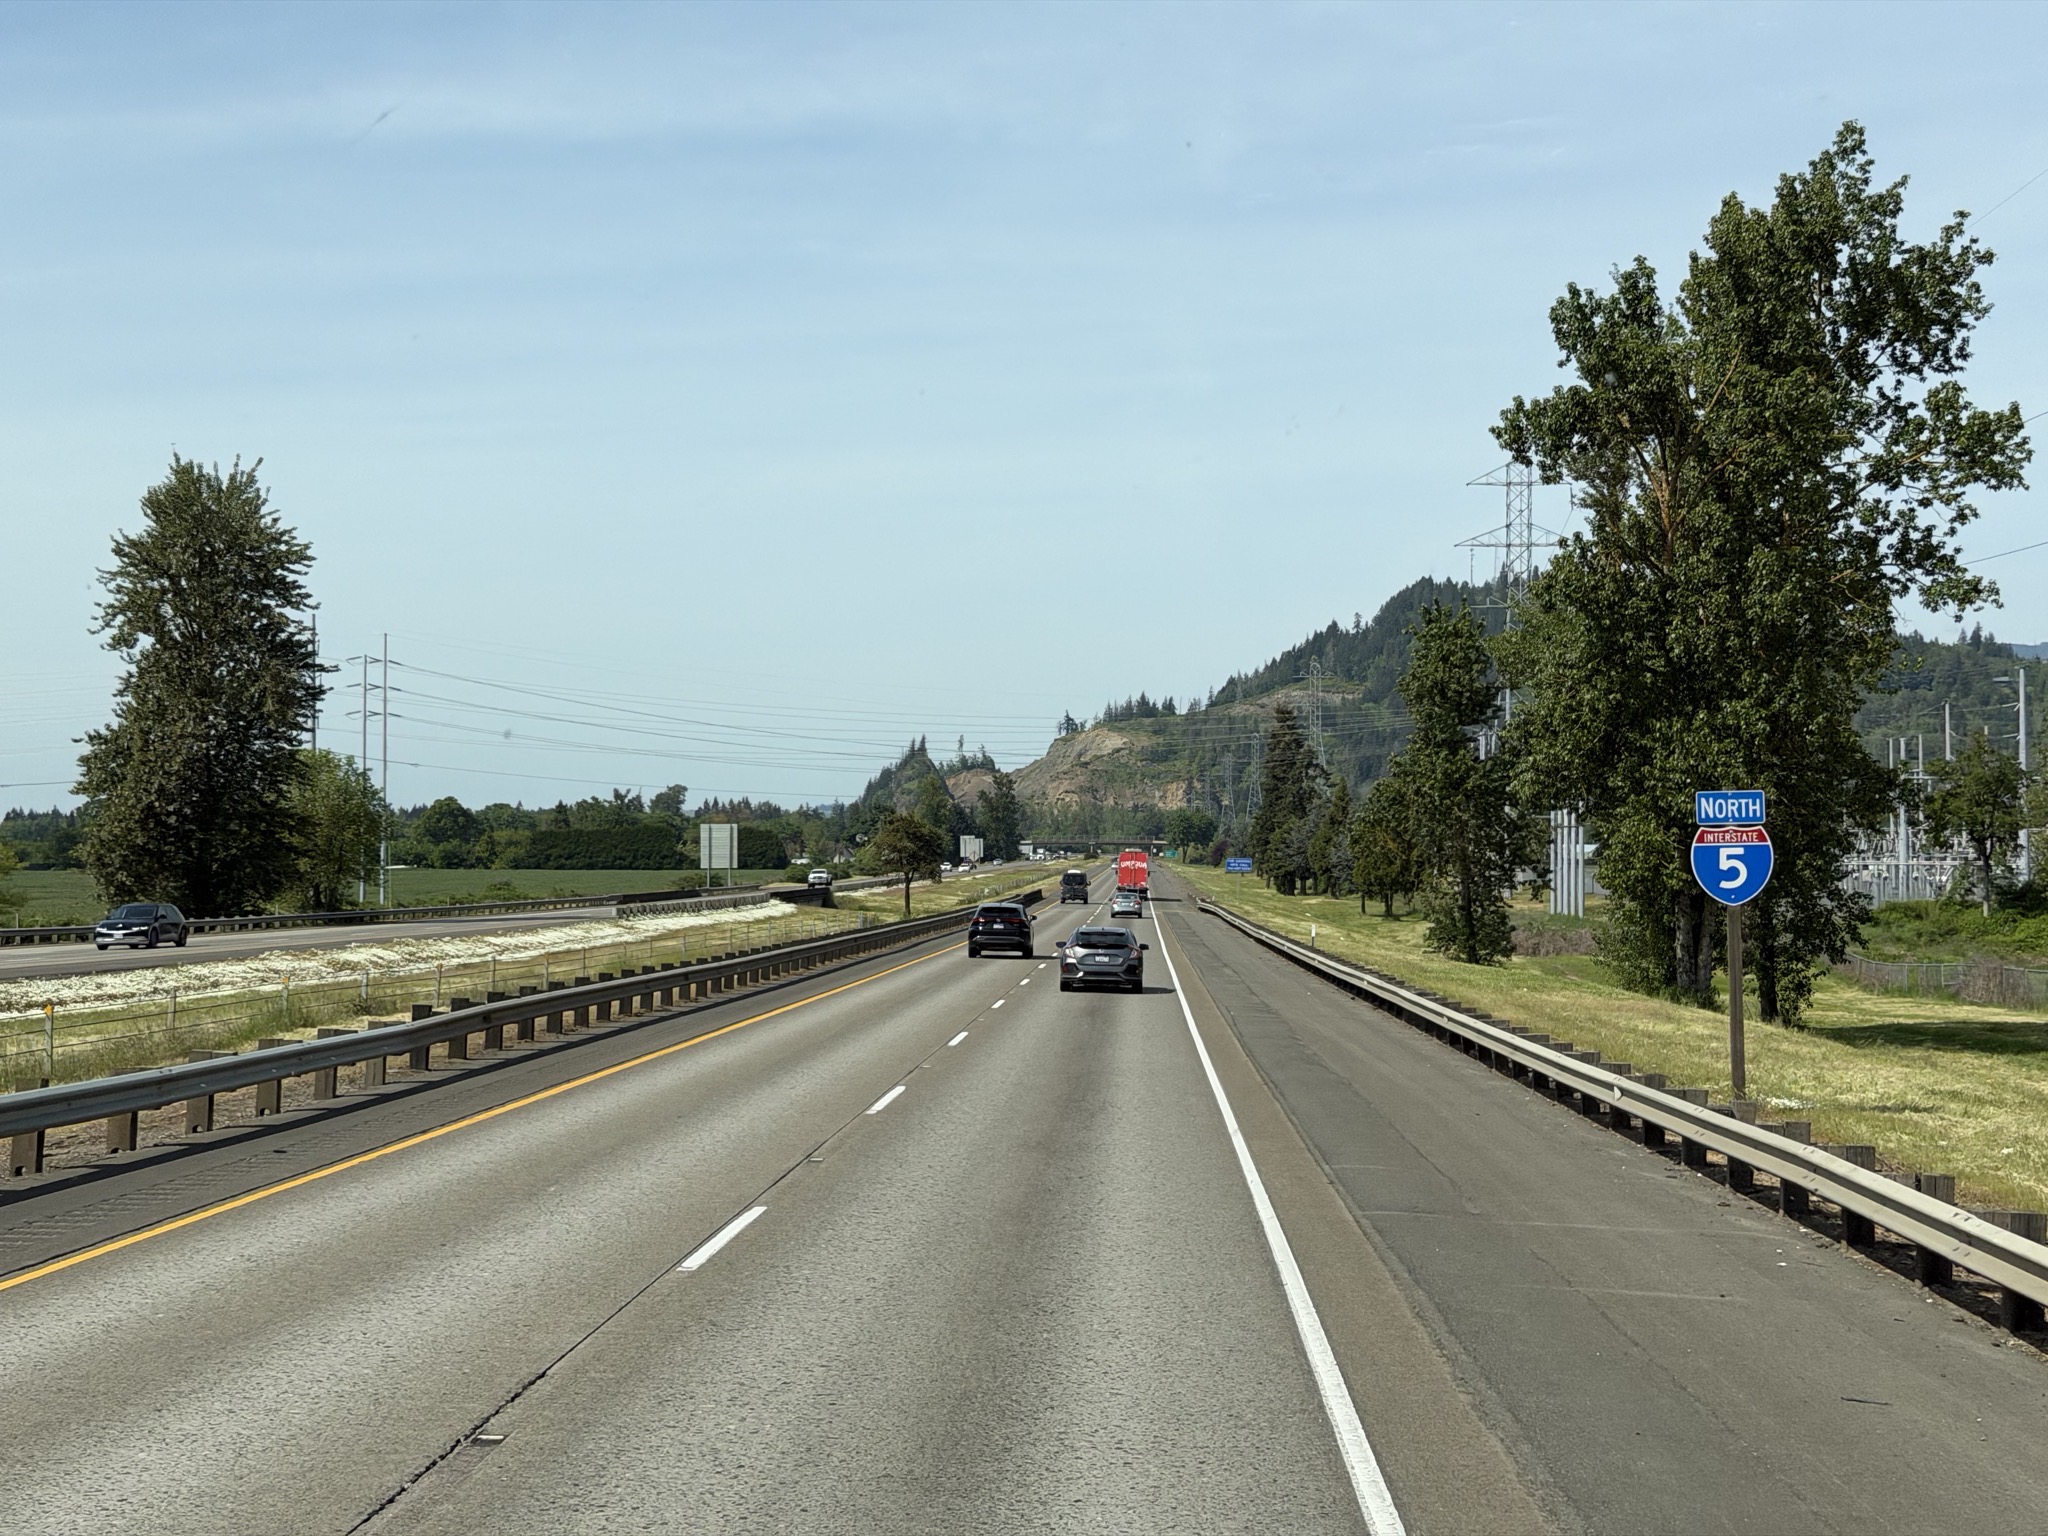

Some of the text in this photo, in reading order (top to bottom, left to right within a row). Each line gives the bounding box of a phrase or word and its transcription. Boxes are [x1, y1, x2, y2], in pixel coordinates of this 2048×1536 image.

[1700, 797, 1760, 818] NORTH
[1703, 832, 1758, 842] INTERSTATE
[1719, 847, 1747, 889] 5
